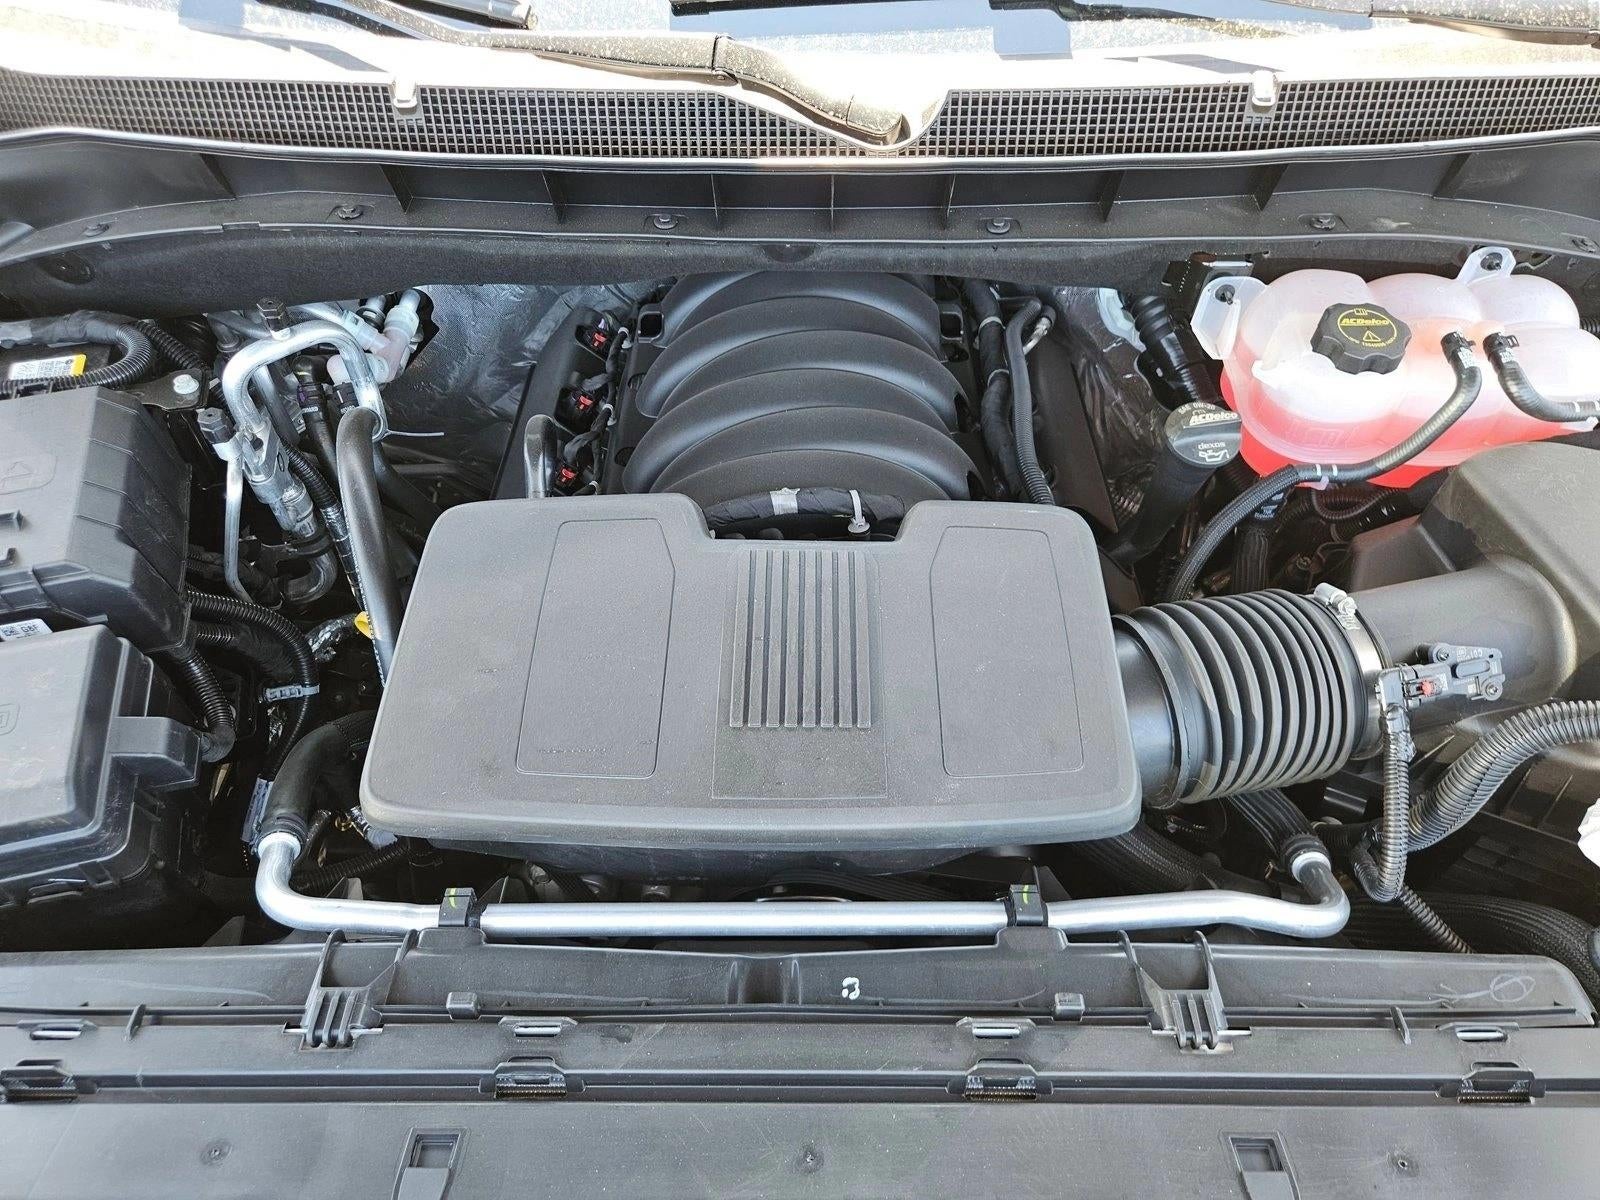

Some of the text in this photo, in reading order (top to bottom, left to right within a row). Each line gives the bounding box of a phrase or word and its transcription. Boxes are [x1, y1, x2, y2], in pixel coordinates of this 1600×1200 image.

[1341, 318, 1390, 326] ACDelco
[1178, 404, 1191, 414] SAE
[1189, 412, 1238, 426] ACDelco
[1198, 442, 1226, 450] dexos
